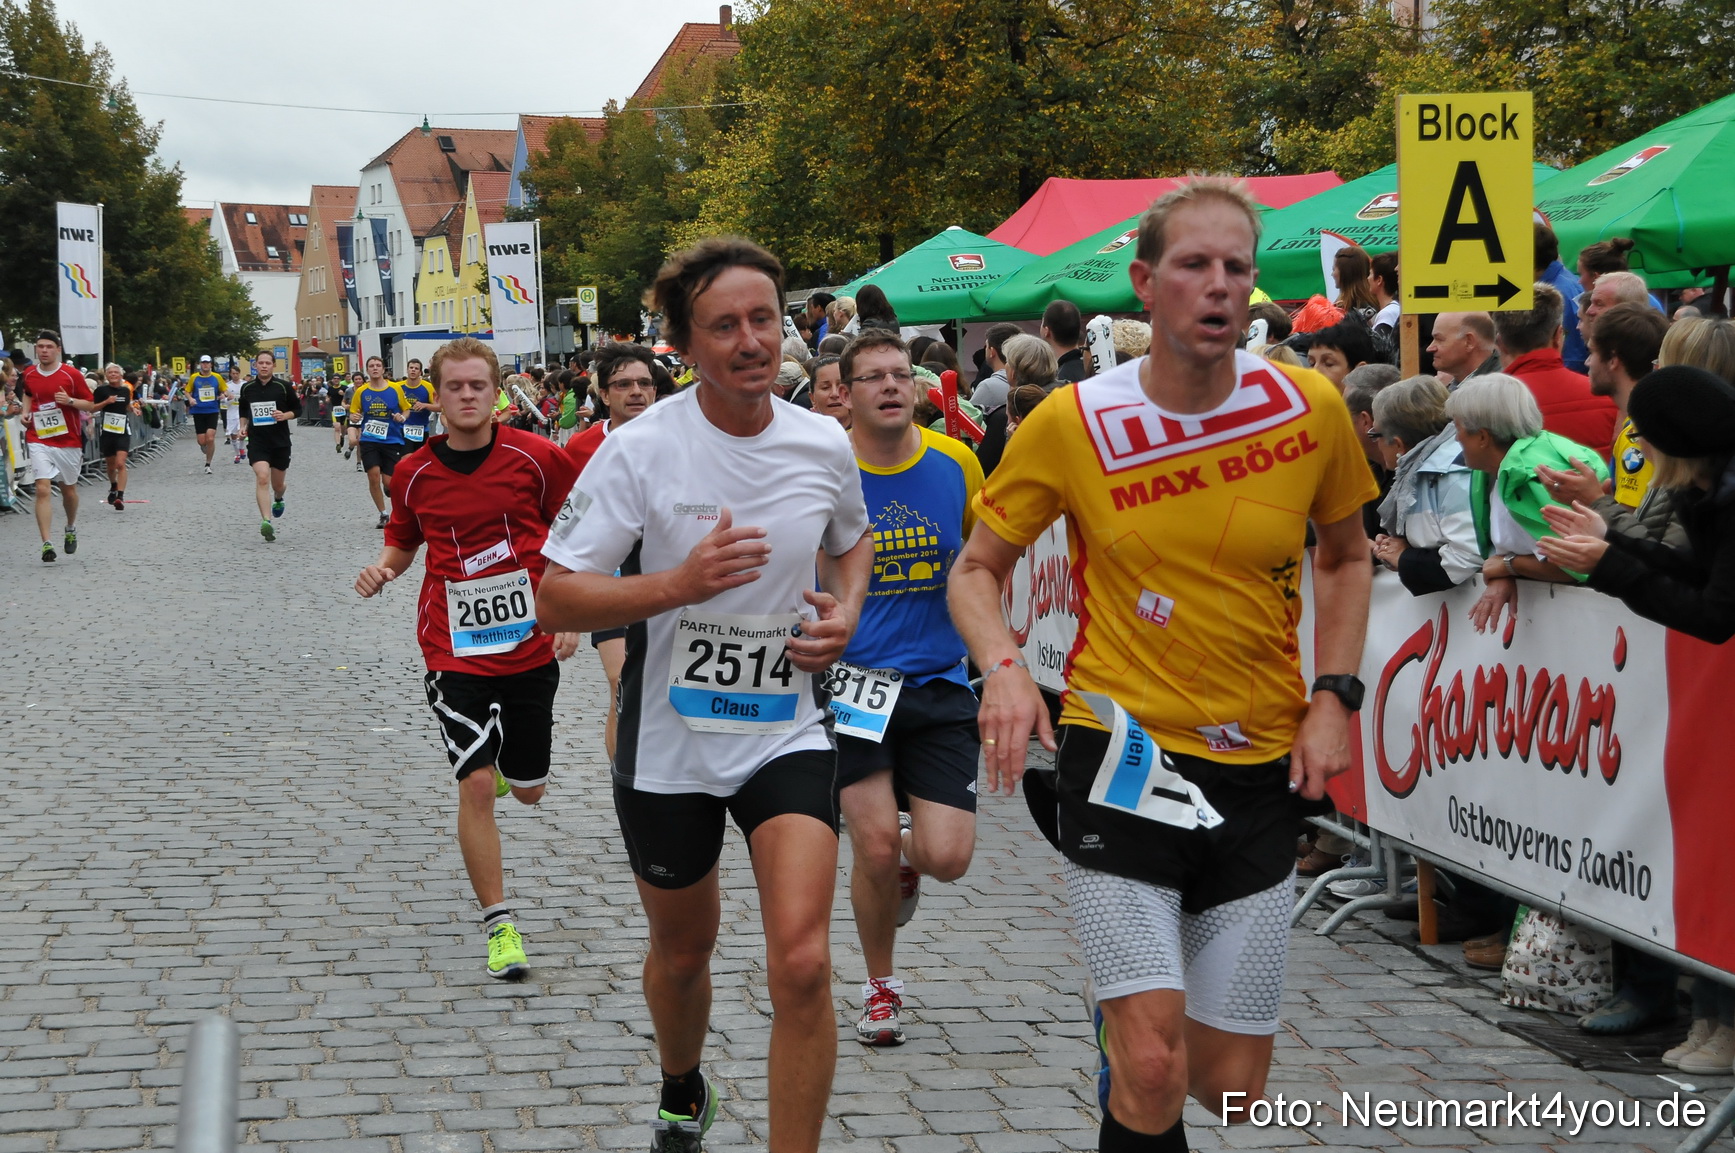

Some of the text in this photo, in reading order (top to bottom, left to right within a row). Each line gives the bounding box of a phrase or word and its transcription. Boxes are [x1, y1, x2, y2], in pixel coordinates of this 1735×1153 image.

[1417, 103, 1520, 141] Block
[1429, 160, 1506, 264] A
[40, 416, 59, 427] 145
[110, 418, 119, 426] 37
[367, 424, 386, 435] 2765
[1109, 430, 1319, 511] MAX BÖGL
[477, 551, 498, 566] DEHN
[474, 580, 515, 595] Neumarkt
[457, 591, 528, 627] 2660
[471, 628, 521, 644] Matthias
[679, 620, 787, 639] PARTL Neumarkt
[684, 639, 793, 688] 2514
[711, 697, 760, 717] Claus
[1372, 601, 1627, 799] Charivari
[1448, 795, 1652, 901] Ostbayerns Radio
